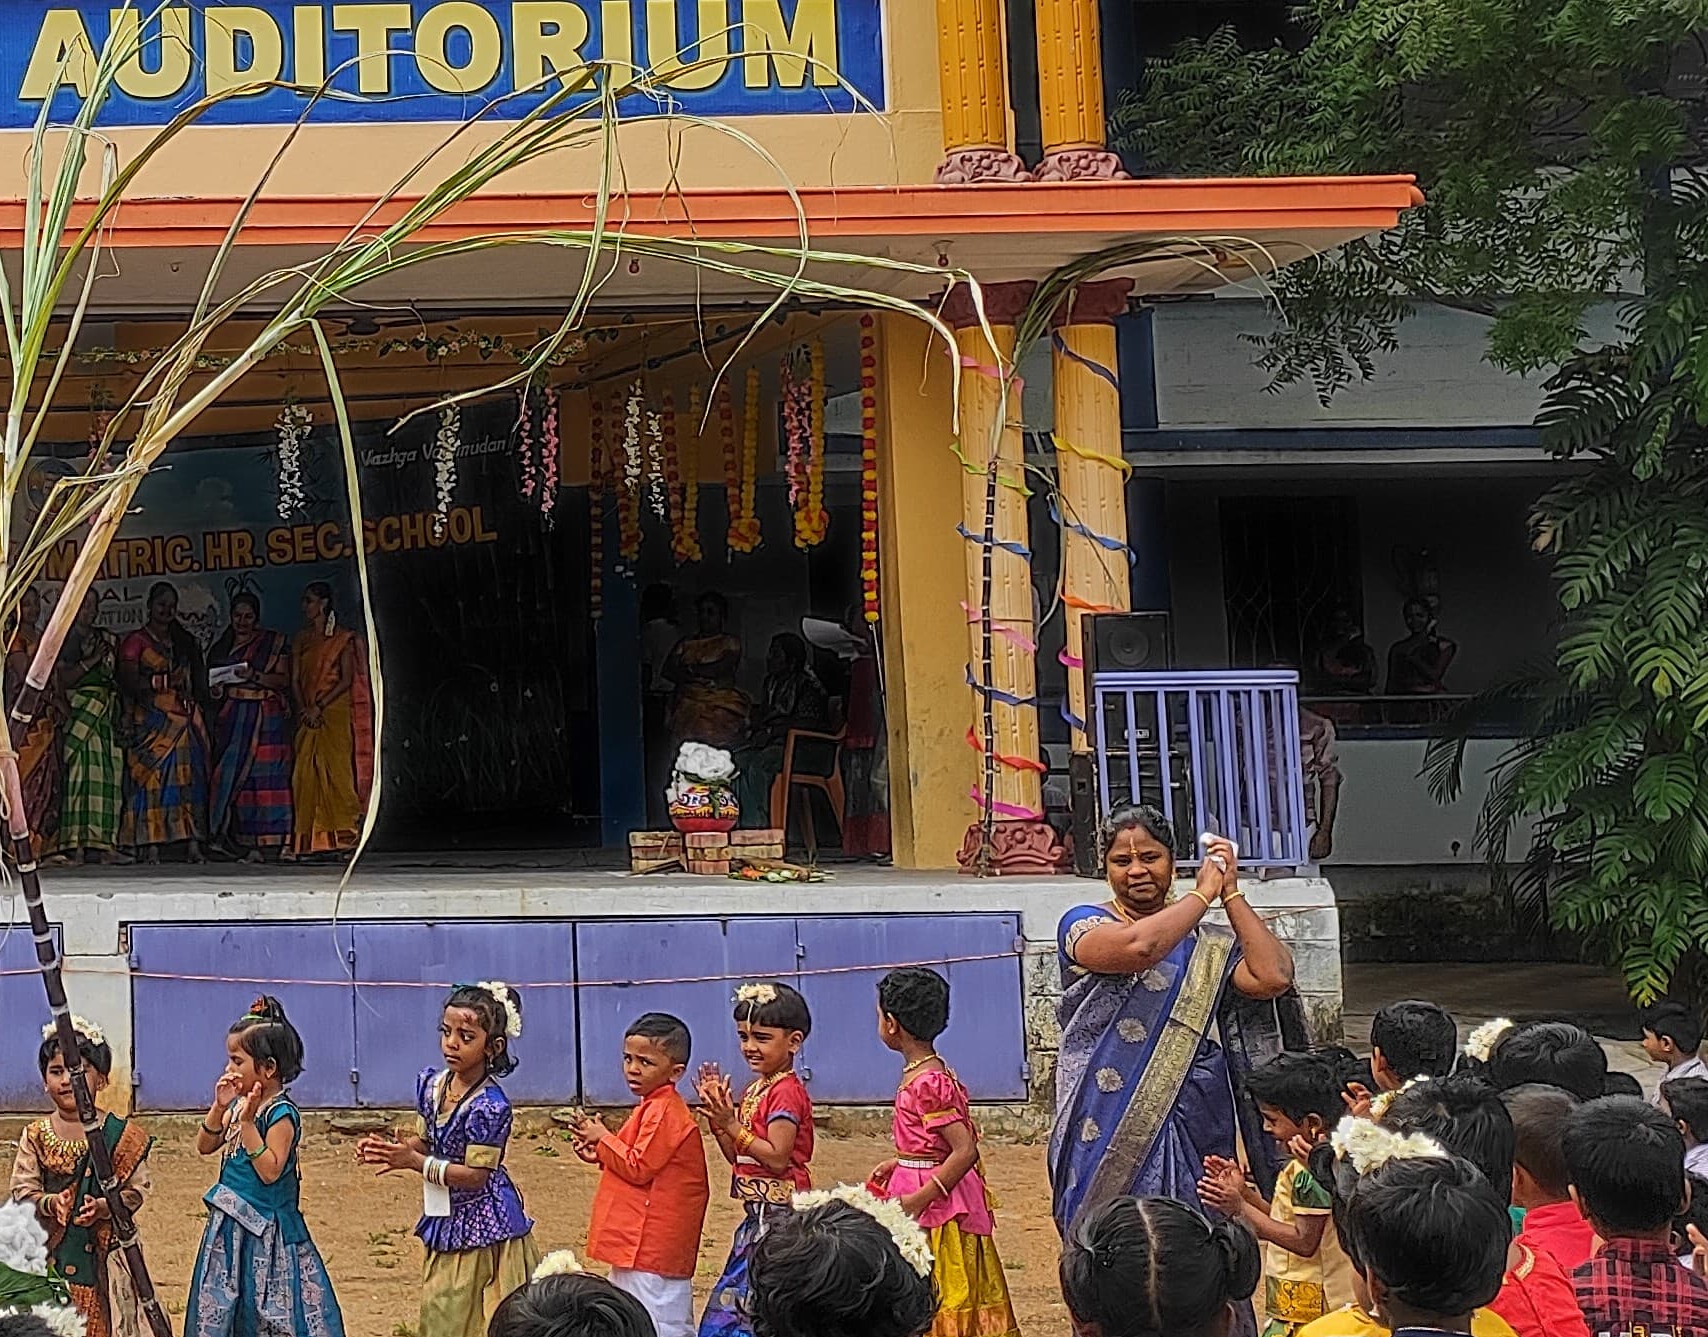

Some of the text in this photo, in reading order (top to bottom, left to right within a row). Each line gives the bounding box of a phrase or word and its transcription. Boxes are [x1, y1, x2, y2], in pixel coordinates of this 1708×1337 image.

[18, 0, 840, 101] AUDITORIUM
[359, 432, 517, 470] Vazhga Vamudan!!
[45, 536, 202, 581] MTRIC.
[204, 528, 265, 571] HR.
[267, 519, 353, 565] SEC.
[362, 505, 499, 555] SCHOOL
